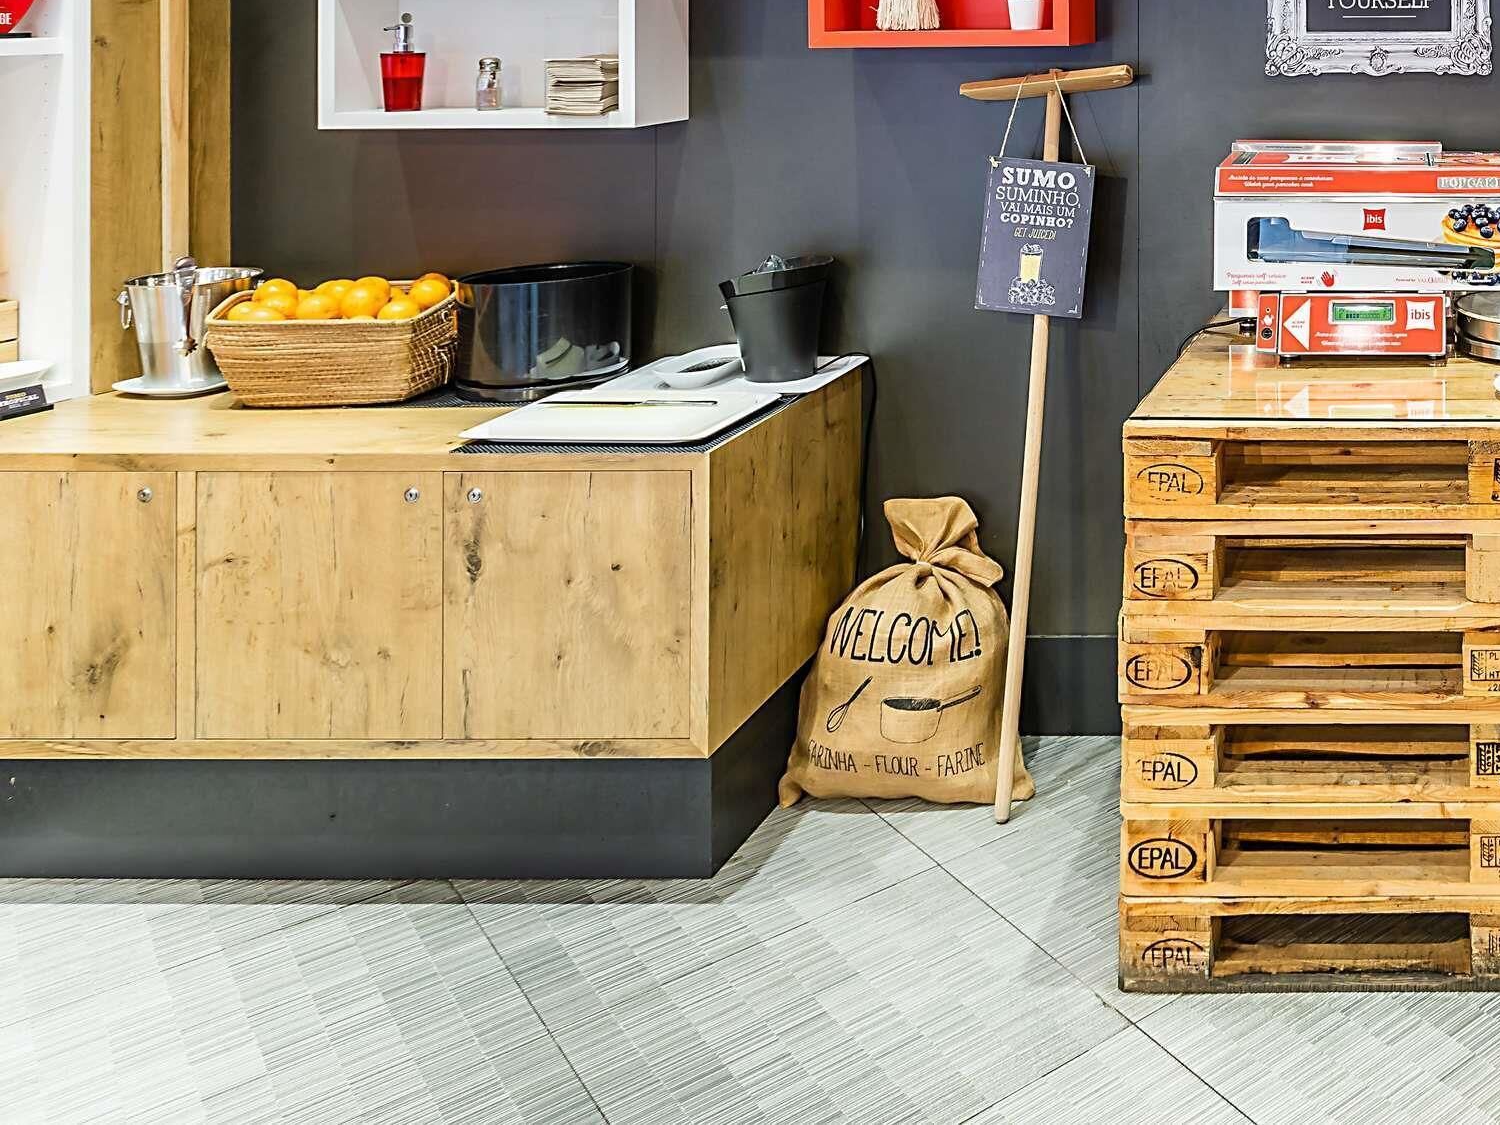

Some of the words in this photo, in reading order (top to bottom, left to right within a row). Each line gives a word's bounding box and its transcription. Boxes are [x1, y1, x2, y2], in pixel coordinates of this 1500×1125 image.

[1001, 166, 1078, 192] SUMO,
[996, 186, 1081, 209] SUMINHO,
[1000, 202, 1021, 213] VAI
[1024, 203, 1053, 216] MAIS
[1056, 206, 1076, 218] UM
[1000, 212, 1074, 229] COPINHO?
[1366, 214, 1382, 224] ibis
[1411, 309, 1431, 320] ibis
[1148, 472, 1192, 493] EPAL
[830, 606, 982, 666] WELCOME!
[1489, 652, 1499, 660] PL
[807, 739, 858, 773] FARINHA
[875, 754, 920, 777] FLOUR
[937, 742, 986, 777] FARINE
[1141, 760, 1188, 782] EPAL
[1138, 848, 1186, 870] EPAL
[1151, 946, 1198, 968] EPAL
